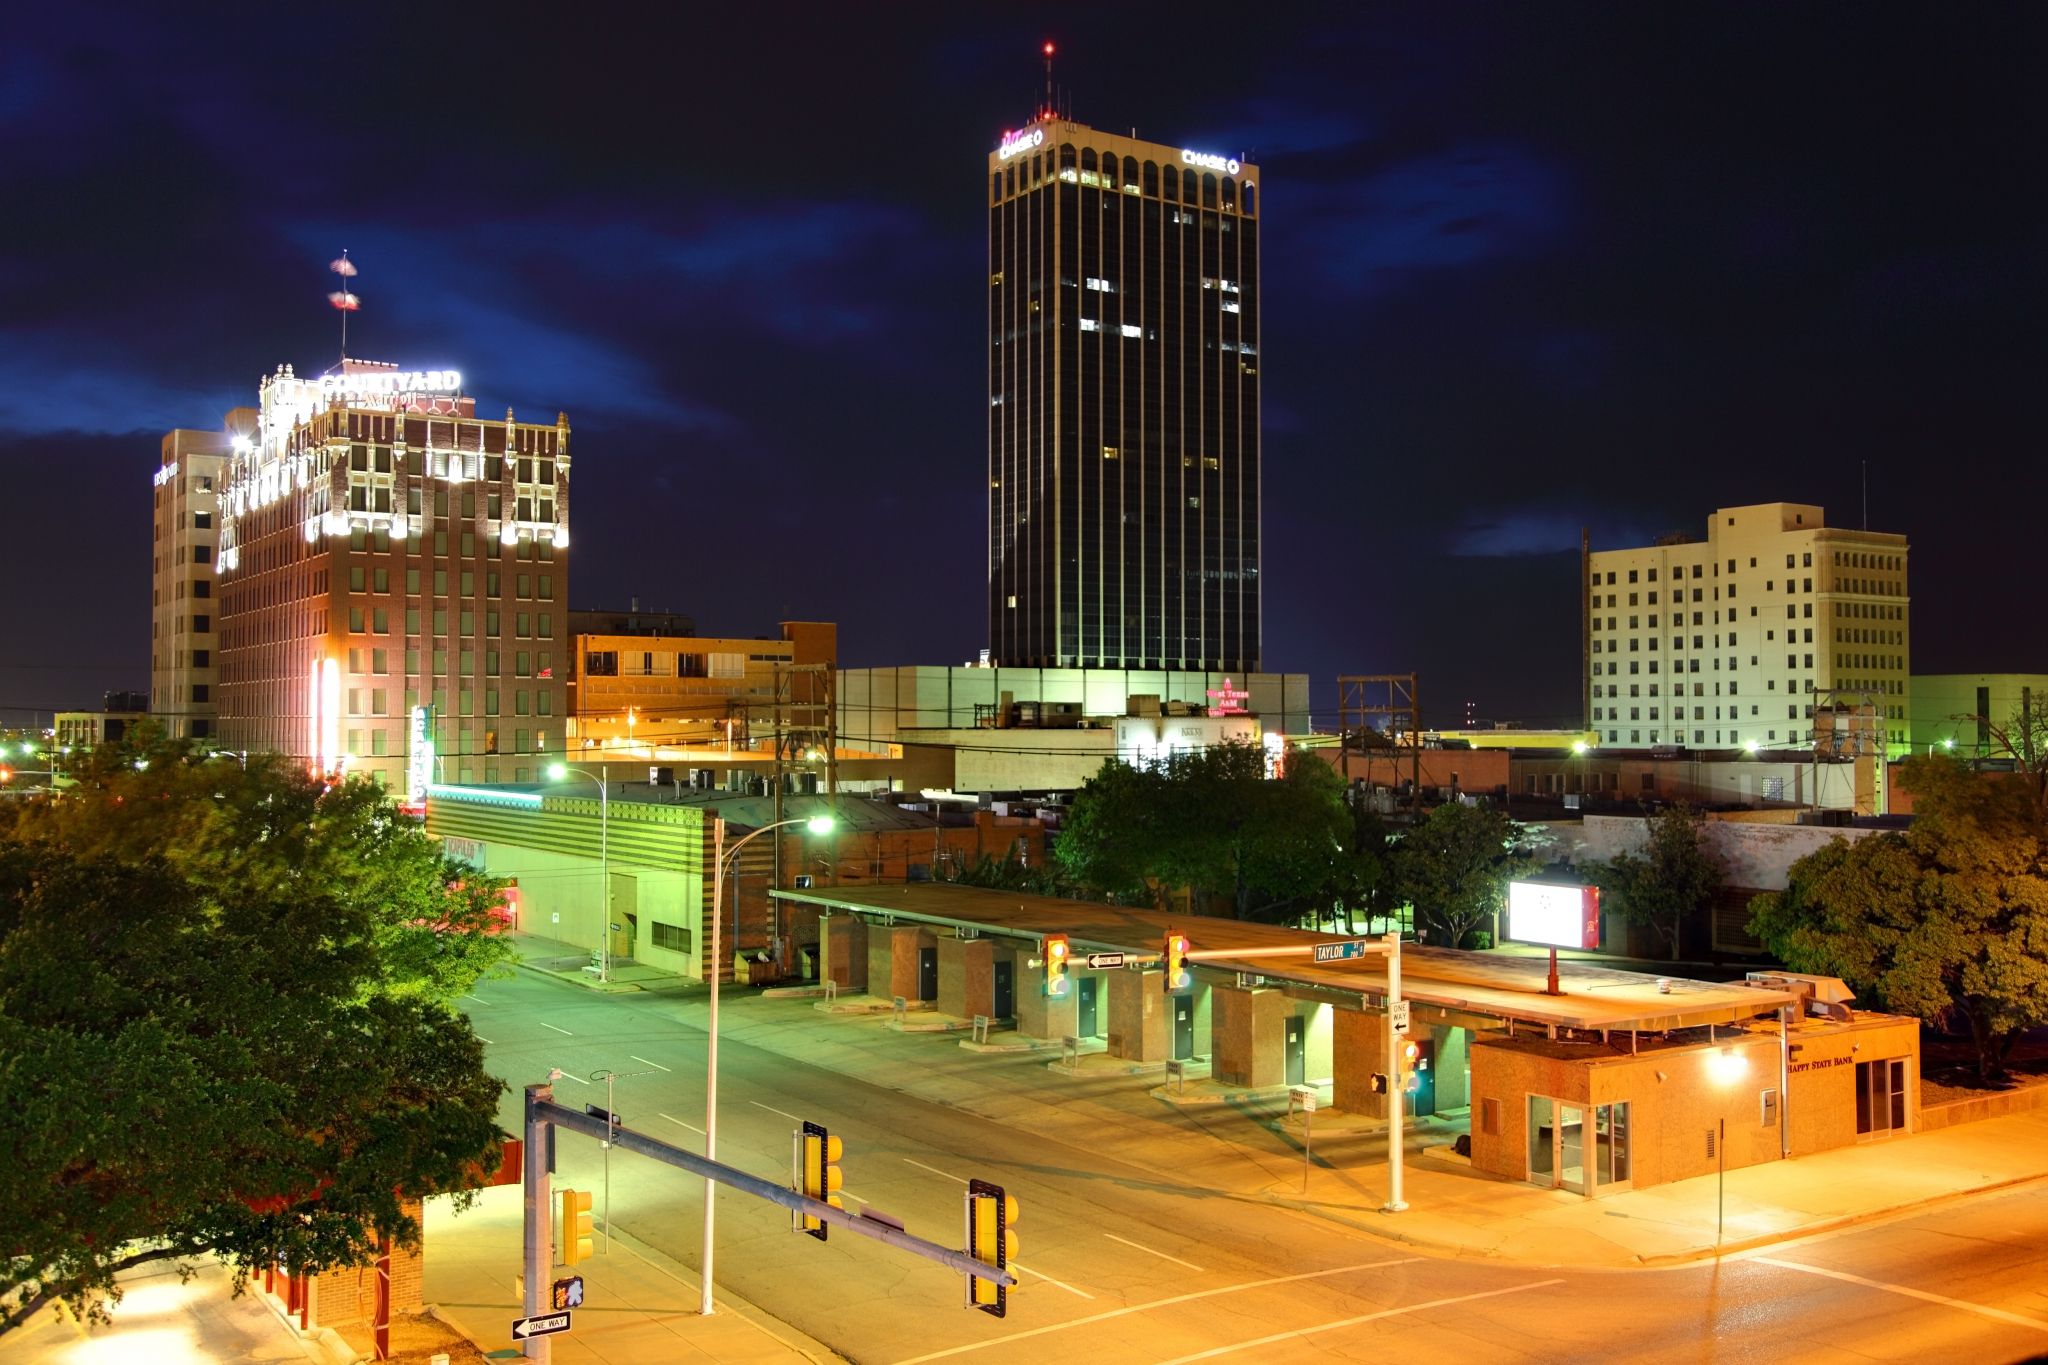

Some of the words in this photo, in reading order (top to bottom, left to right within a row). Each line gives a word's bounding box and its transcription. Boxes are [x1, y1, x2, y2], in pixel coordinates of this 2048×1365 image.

[1000, 134, 1034, 160] CHASE
[1182, 149, 1227, 171] CHASE
[319, 371, 461, 394] COURTYARD
[1317, 945, 1344, 960] TAYLOR
[1393, 1004, 1406, 1012] ONE
[1393, 1012, 1406, 1021] WAY
[1787, 1062, 1809, 1073] HAPPY
[1812, 1059, 1832, 1070] STATE
[1834, 1056, 1853, 1066] BANK
[529, 1320, 547, 1331] ONE
[548, 1317, 565, 1327] WAY
